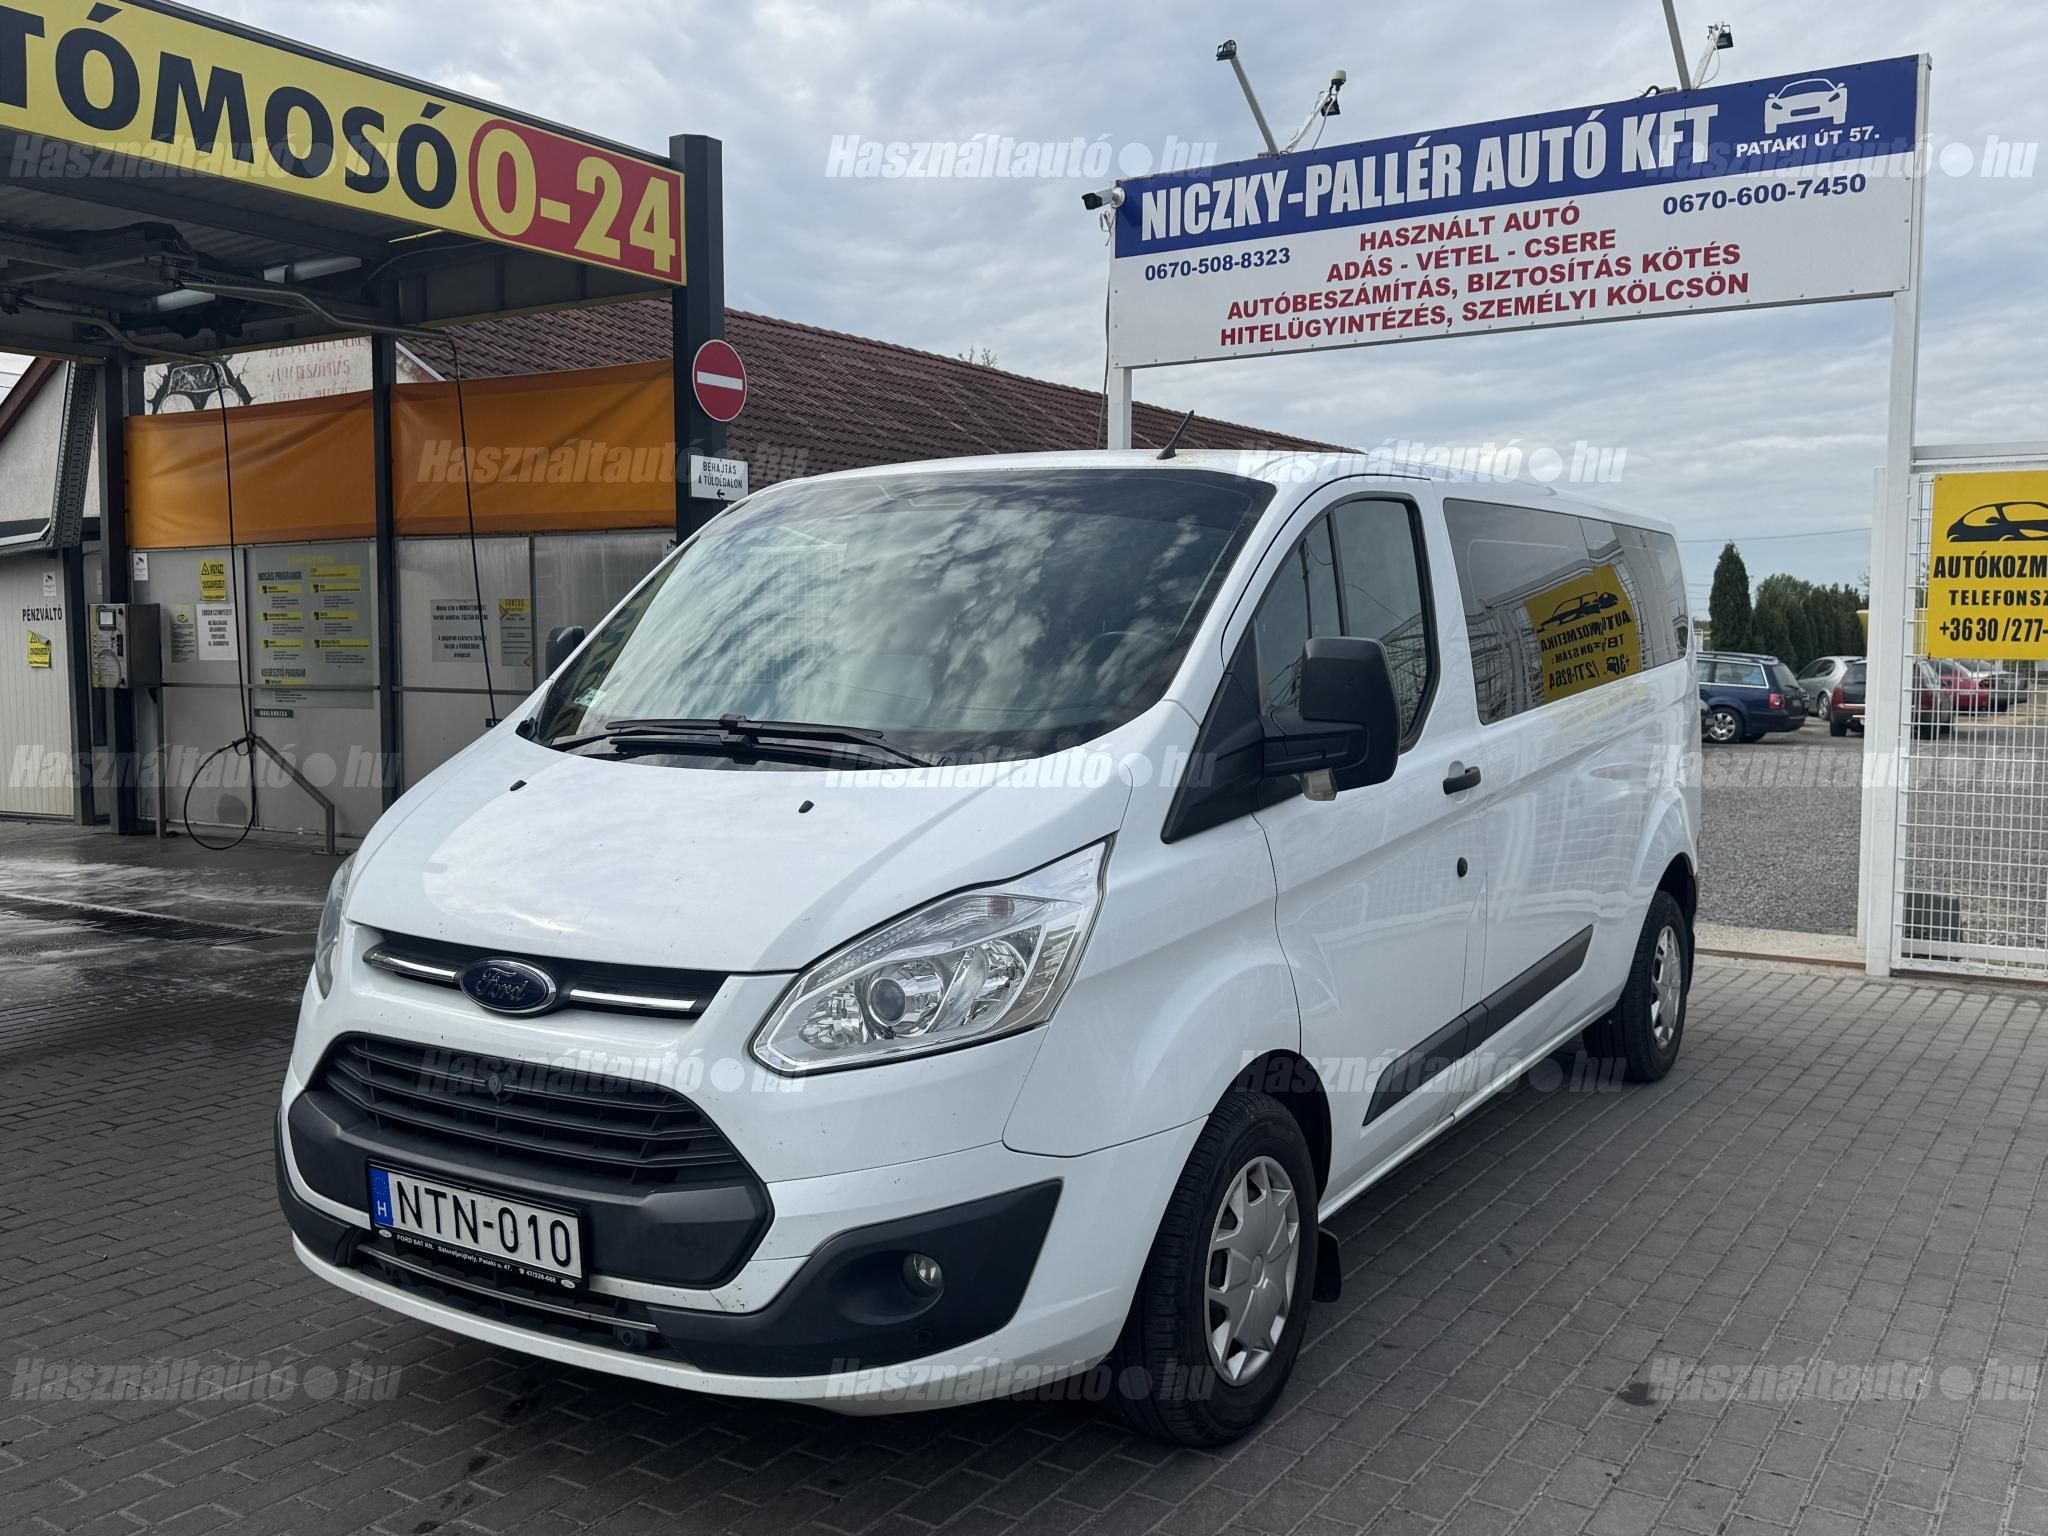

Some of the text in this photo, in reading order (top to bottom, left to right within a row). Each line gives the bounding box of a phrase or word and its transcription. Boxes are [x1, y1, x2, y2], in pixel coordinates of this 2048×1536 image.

[1735, 126, 1880, 158] PATAKI ÚT 57.
[1141, 103, 1718, 241] NICZKY-PALLÉR AUTÓ KFT
[476, 127, 676, 272] 0-24
[1663, 173, 1866, 215] 0670-600-7450
[1360, 200, 1579, 251] HASZNÁLT AUTÓ
[1145, 247, 1291, 281] 0670-508-8323
[1327, 251, 1392, 282] ADÁS
[1416, 241, 1499, 271] VÉTEL
[1525, 229, 1616, 258] CSERE
[1228, 241, 1741, 320] AUTÓBESZÁMÍTÁS, BIZTOSÍTÁS KÖTÉS
[1221, 272, 1749, 346] HITELÜGYINTÉZÉS, SZEMÉLYI KÖLCSÖN
[698, 474, 742, 489] A TÚLOLDALON
[703, 461, 737, 475] BEHAJTÁS
[1933, 550, 2048, 580] AUTÓKOZM
[22, 604, 63, 622] PÉNZVÁLTÓ
[475, 967, 529, 1002] Ford
[376, 1201, 388, 1218] H
[396, 1180, 572, 1268] NTN-010
[396, 1234, 413, 1244] FORD
